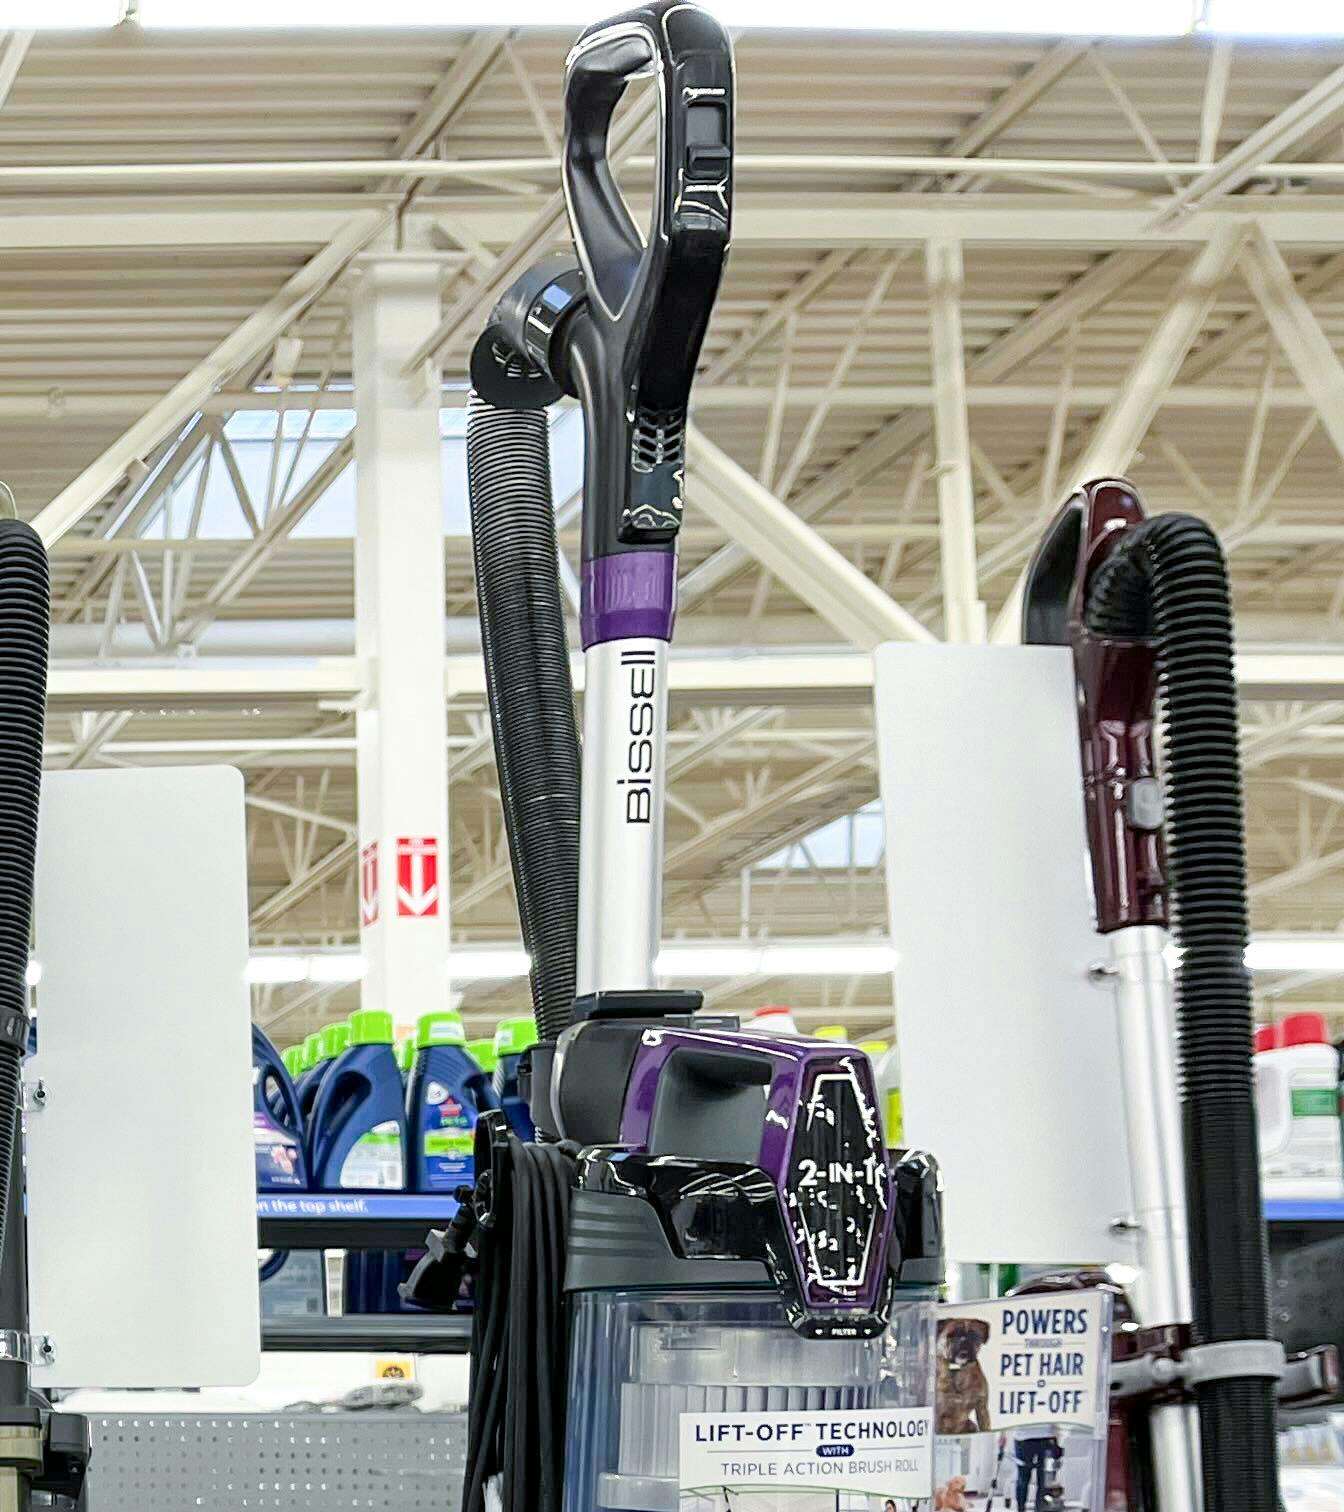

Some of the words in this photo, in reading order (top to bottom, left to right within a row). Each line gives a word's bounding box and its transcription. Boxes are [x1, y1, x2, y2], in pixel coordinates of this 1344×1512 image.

[616, 650, 656, 824] BISSELL
[300, 1201, 325, 1216] top
[1002, 1309, 1089, 1336] POWERS
[1000, 1352, 1034, 1378] PET
[1039, 1352, 1084, 1377] HAIR
[999, 1389, 1083, 1415] LIFT-OFF
[815, 1420, 930, 1441] TECHNOLOGY
[821, 1446, 850, 1456] WITH
[721, 1462, 777, 1477] TRIPLE
[783, 1461, 845, 1476] ACTION
[848, 1460, 893, 1475] BRUSH
[895, 1459, 919, 1473] ROLL
